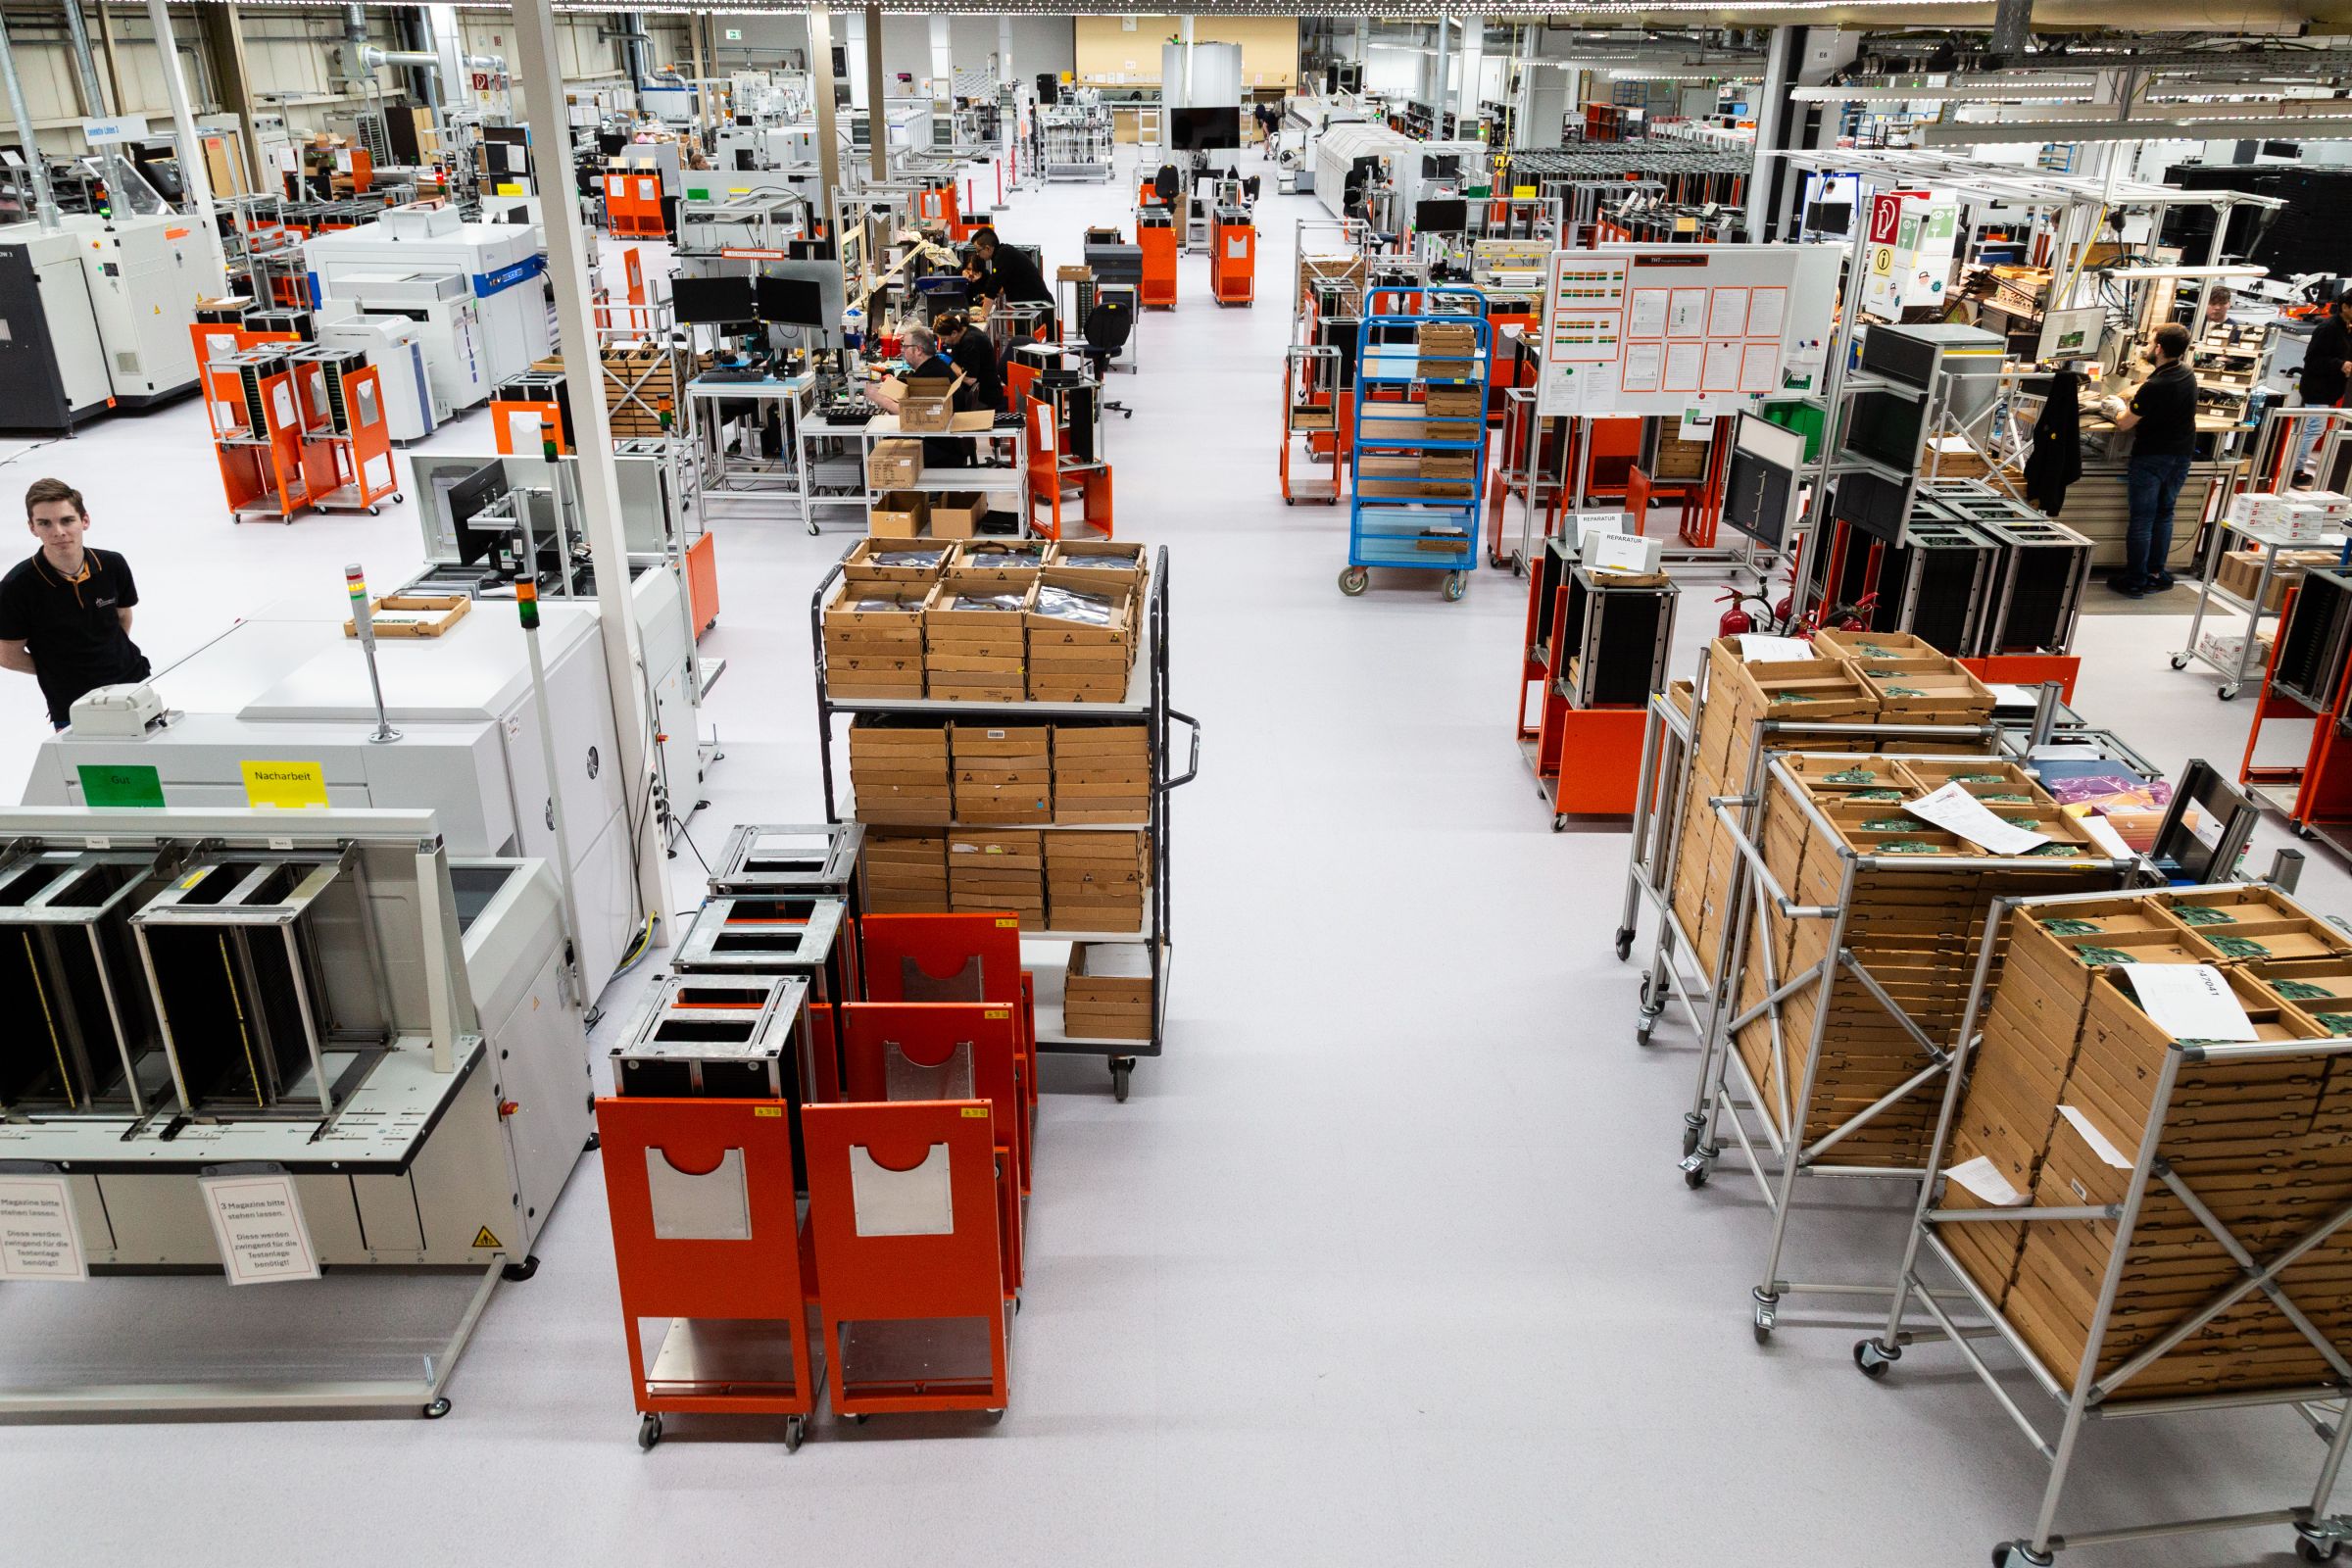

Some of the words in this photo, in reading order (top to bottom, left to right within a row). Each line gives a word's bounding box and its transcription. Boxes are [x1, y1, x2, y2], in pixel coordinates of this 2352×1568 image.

[1606, 534, 1642, 543] REPARATUR
[112, 775, 130, 785] Gut
[255, 771, 312, 781] Nacharbeit
[228, 1200, 266, 1209] Magazine
[234, 1242, 271, 1250] zwingend
[17, 1249, 60, 1257] Testanlage
[248, 1250, 290, 1259] Testanlage
[254, 1259, 290, 1268] benötigt!
